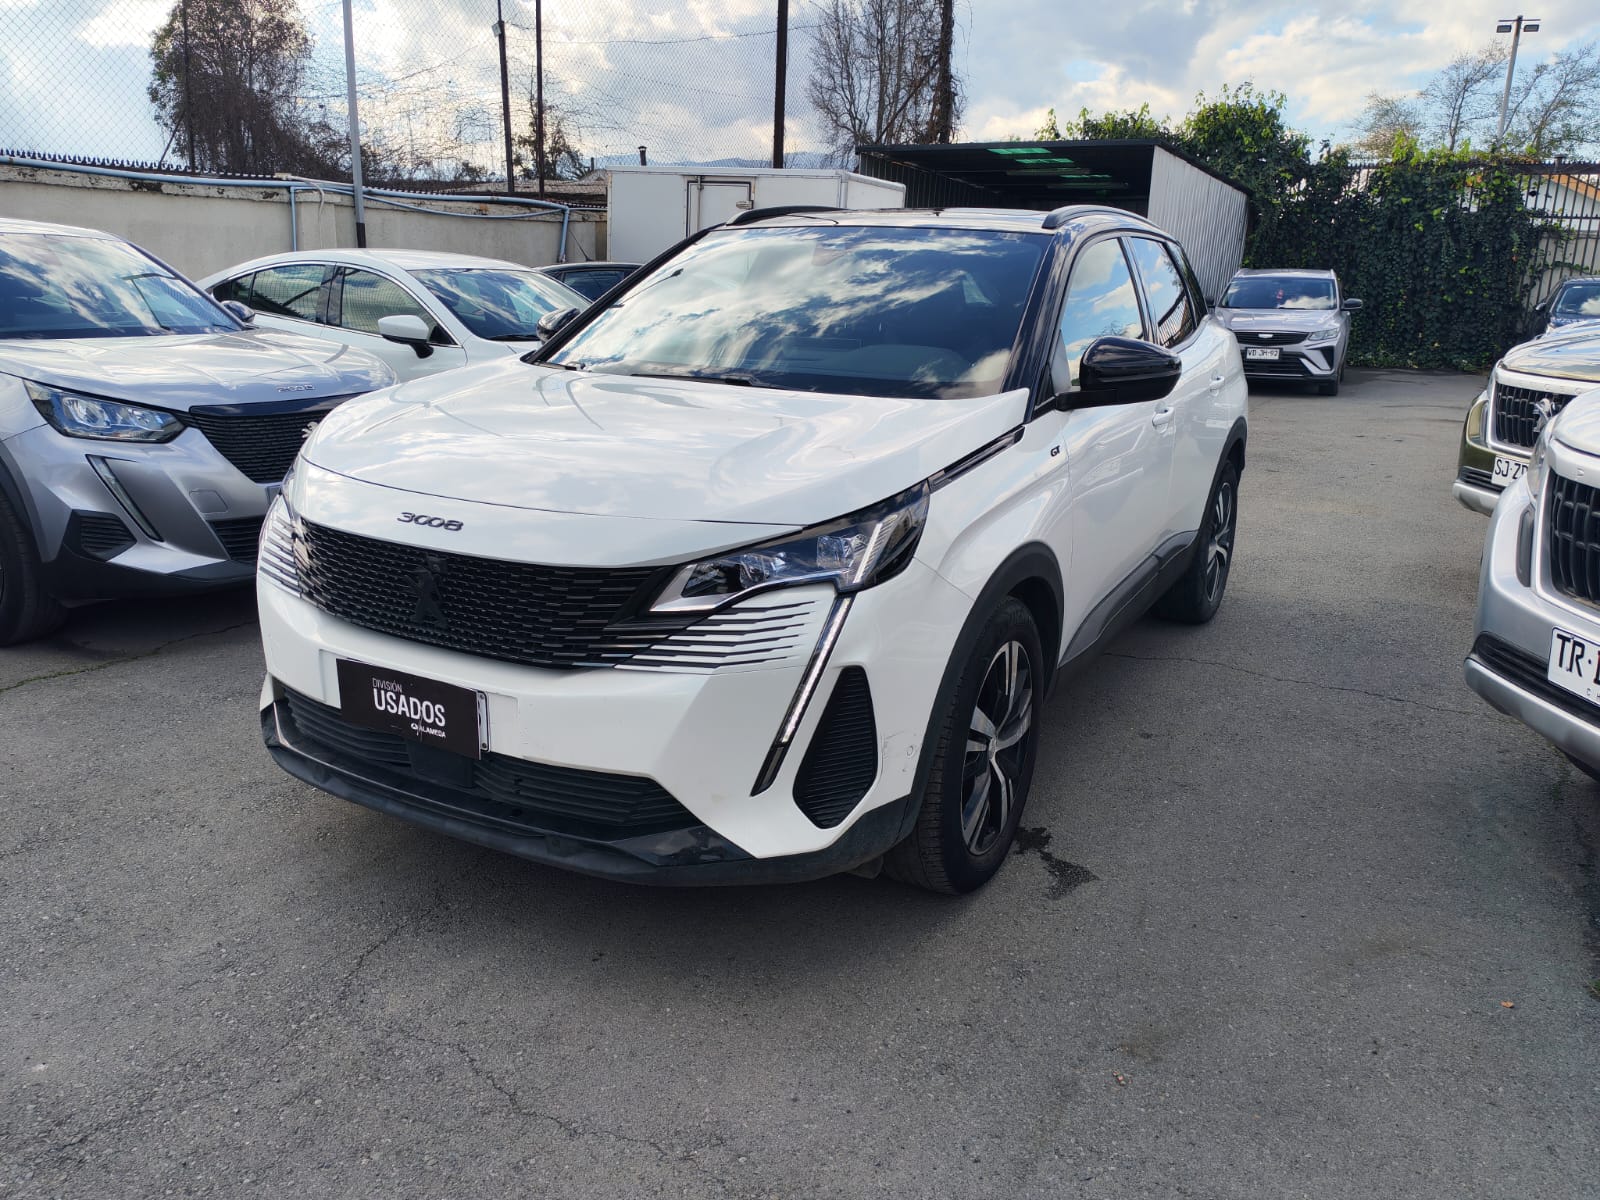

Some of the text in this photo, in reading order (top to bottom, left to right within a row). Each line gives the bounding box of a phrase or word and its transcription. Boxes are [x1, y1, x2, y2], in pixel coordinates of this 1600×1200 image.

[1050, 444, 1060, 457] GT
[396, 511, 464, 532] 3008
[371, 677, 403, 693] DIVISIÓN
[372, 687, 446, 727] USADOS
